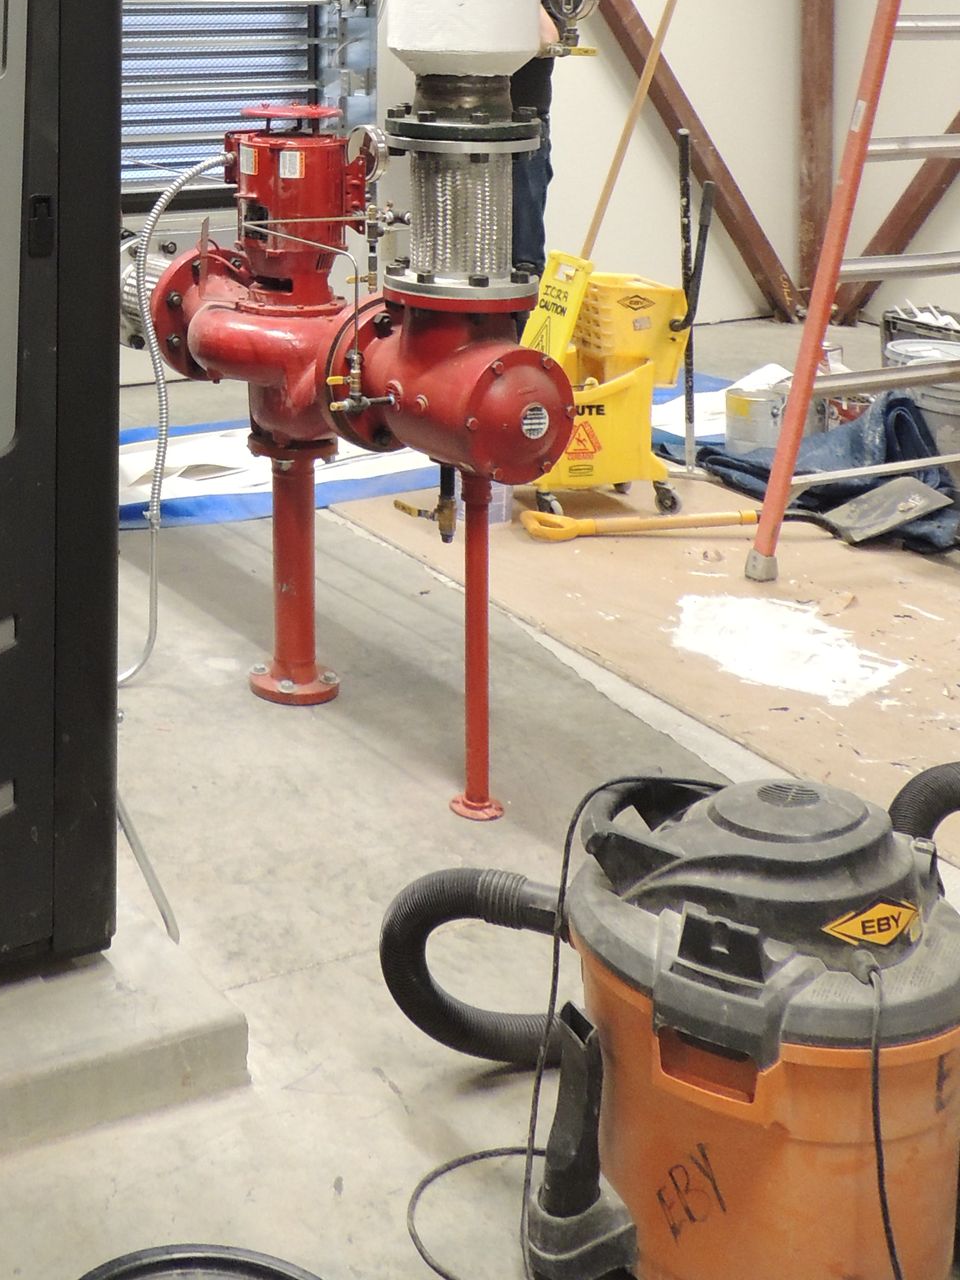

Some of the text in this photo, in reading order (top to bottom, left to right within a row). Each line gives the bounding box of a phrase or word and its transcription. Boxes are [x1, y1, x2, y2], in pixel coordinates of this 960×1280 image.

[539, 298, 568, 317] CAUTION
[576, 404, 606, 417] UTE
[861, 911, 902, 936] EBY
[656, 1142, 727, 1244] EBY
